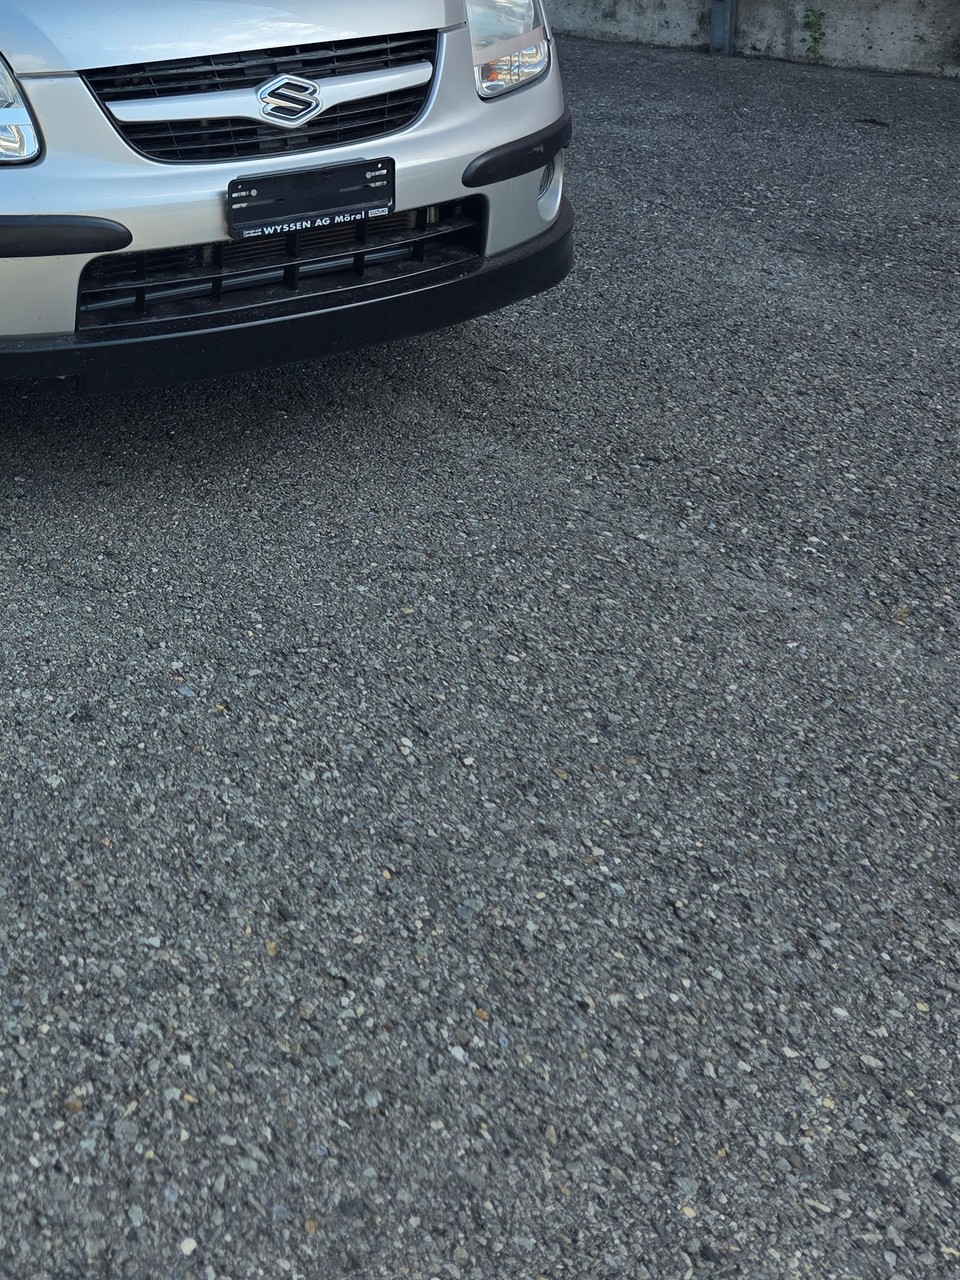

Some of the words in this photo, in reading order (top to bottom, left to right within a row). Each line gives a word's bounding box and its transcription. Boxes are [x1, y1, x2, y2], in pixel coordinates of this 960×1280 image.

[263, 220, 311, 235] WYSSEN
[314, 217, 331, 227] AG
[334, 210, 365, 224] Mörel
